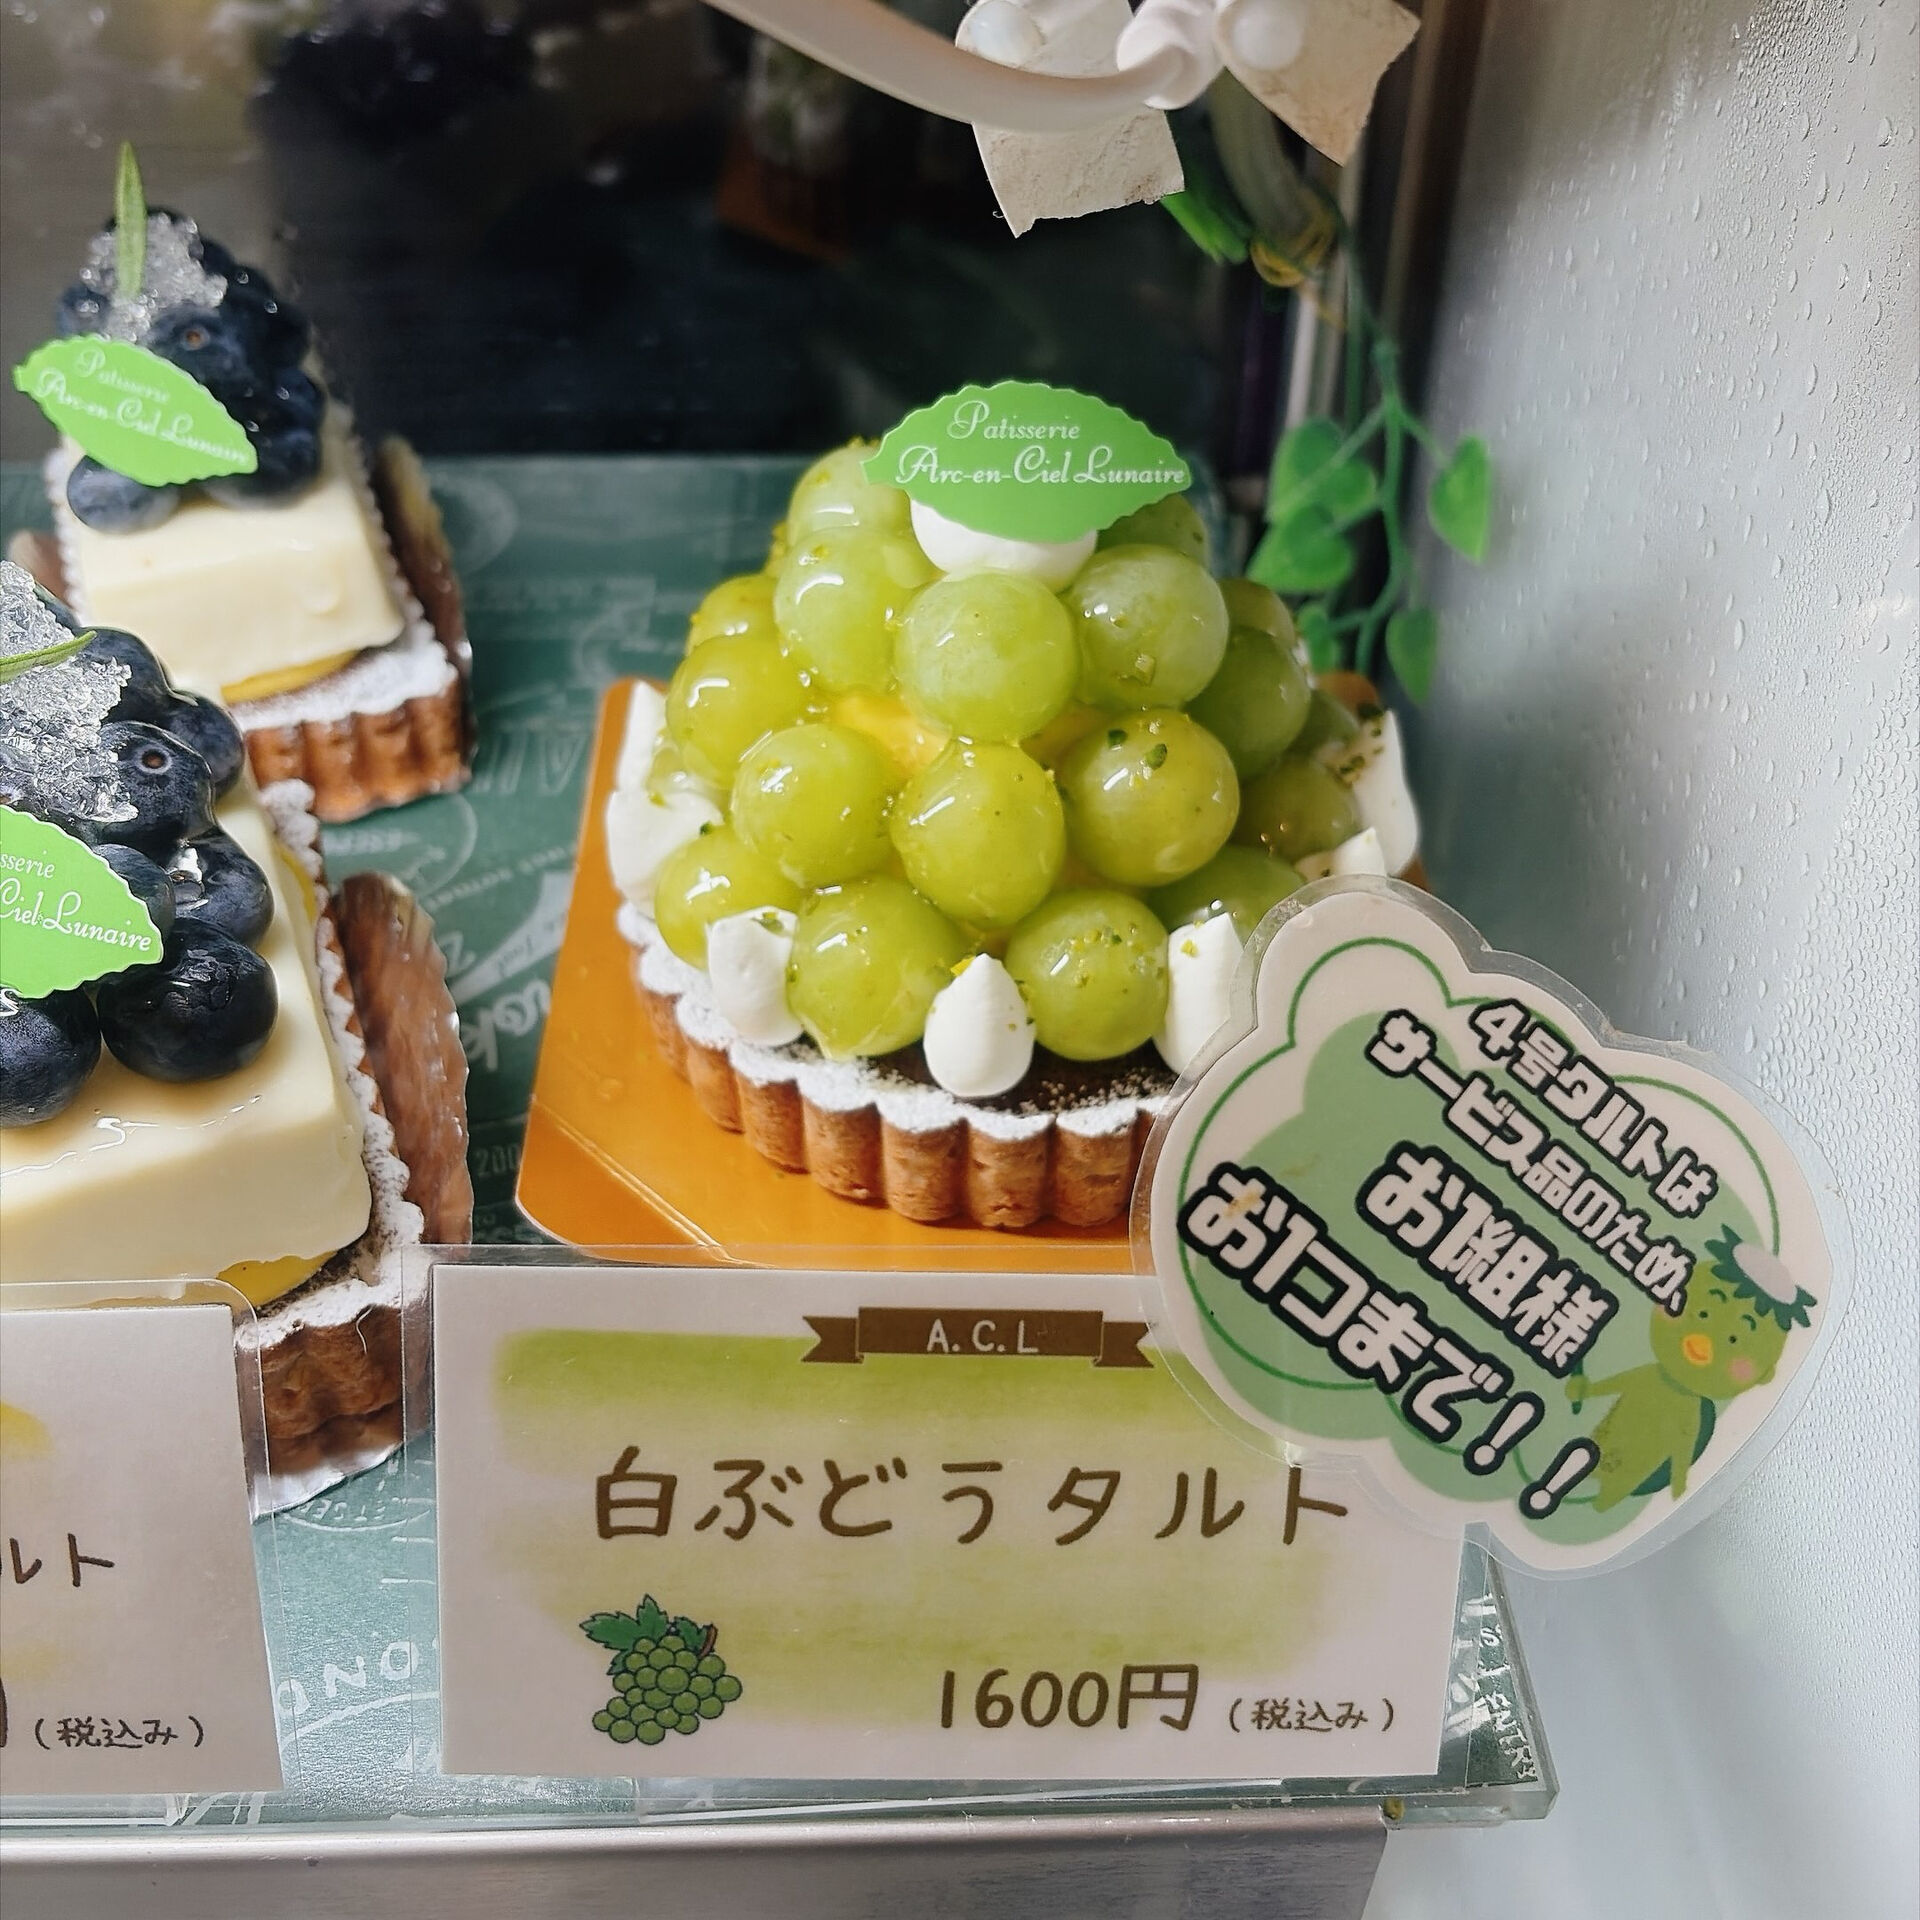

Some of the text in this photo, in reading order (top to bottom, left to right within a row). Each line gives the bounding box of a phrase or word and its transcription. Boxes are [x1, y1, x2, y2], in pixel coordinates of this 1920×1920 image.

[947, 400, 1081, 439] Patisserie
[896, 445, 1185, 483] Arc-en-Ciel Lunaire
[0, 850, 55, 879] sserie
[43, 890, 151, 951] Lunaire
[1470, 1000, 1716, 1216] 4号タルトは
[1367, 1010, 1695, 1315] サービス品のため、
[1358, 1141, 1617, 1377] お1組様
[596, 1446, 1348, 1546] 白ぶどうタルト
[941, 1664, 1394, 1733] 1600円 (税込み)
[35, 1715, 204, 1750] (税込み)
